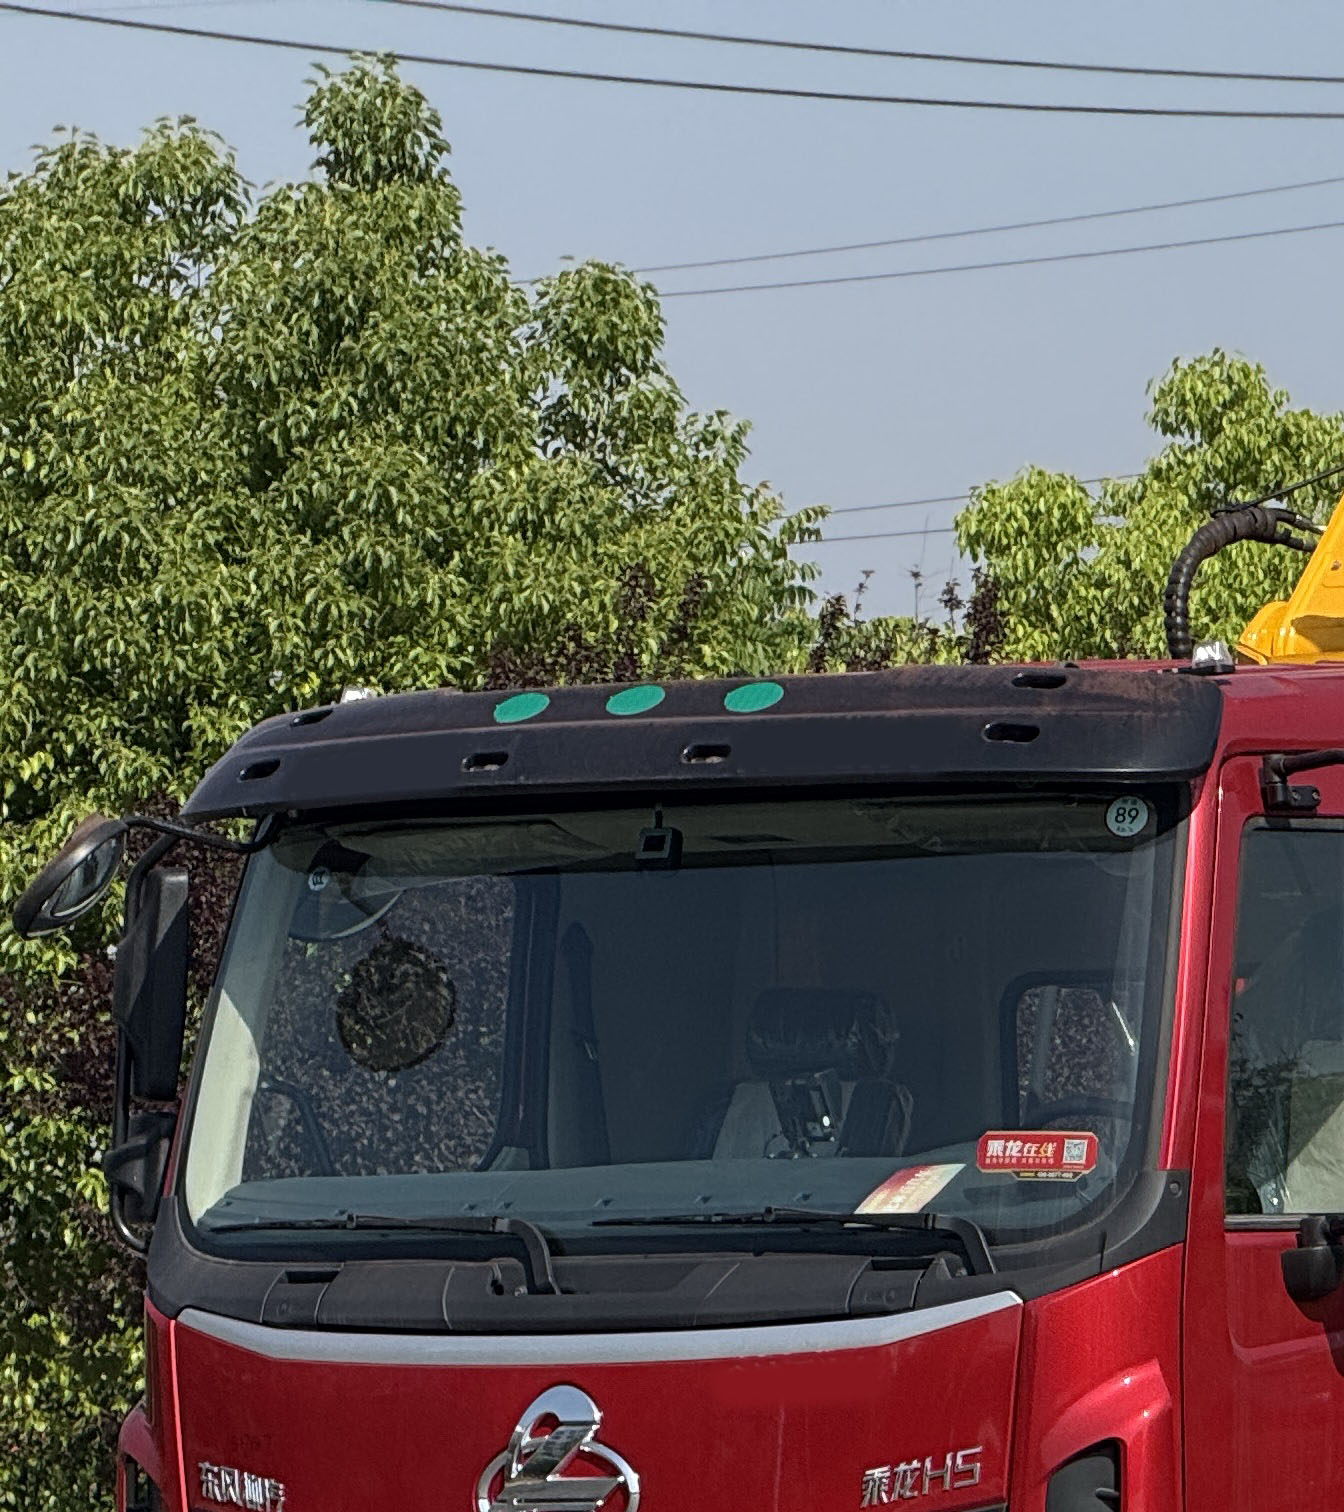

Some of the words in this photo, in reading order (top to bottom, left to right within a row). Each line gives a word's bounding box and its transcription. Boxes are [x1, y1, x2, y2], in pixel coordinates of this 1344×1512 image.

[1115, 807, 1139, 824] 89
[985, 1139, 1057, 1158] 乘龙在线
